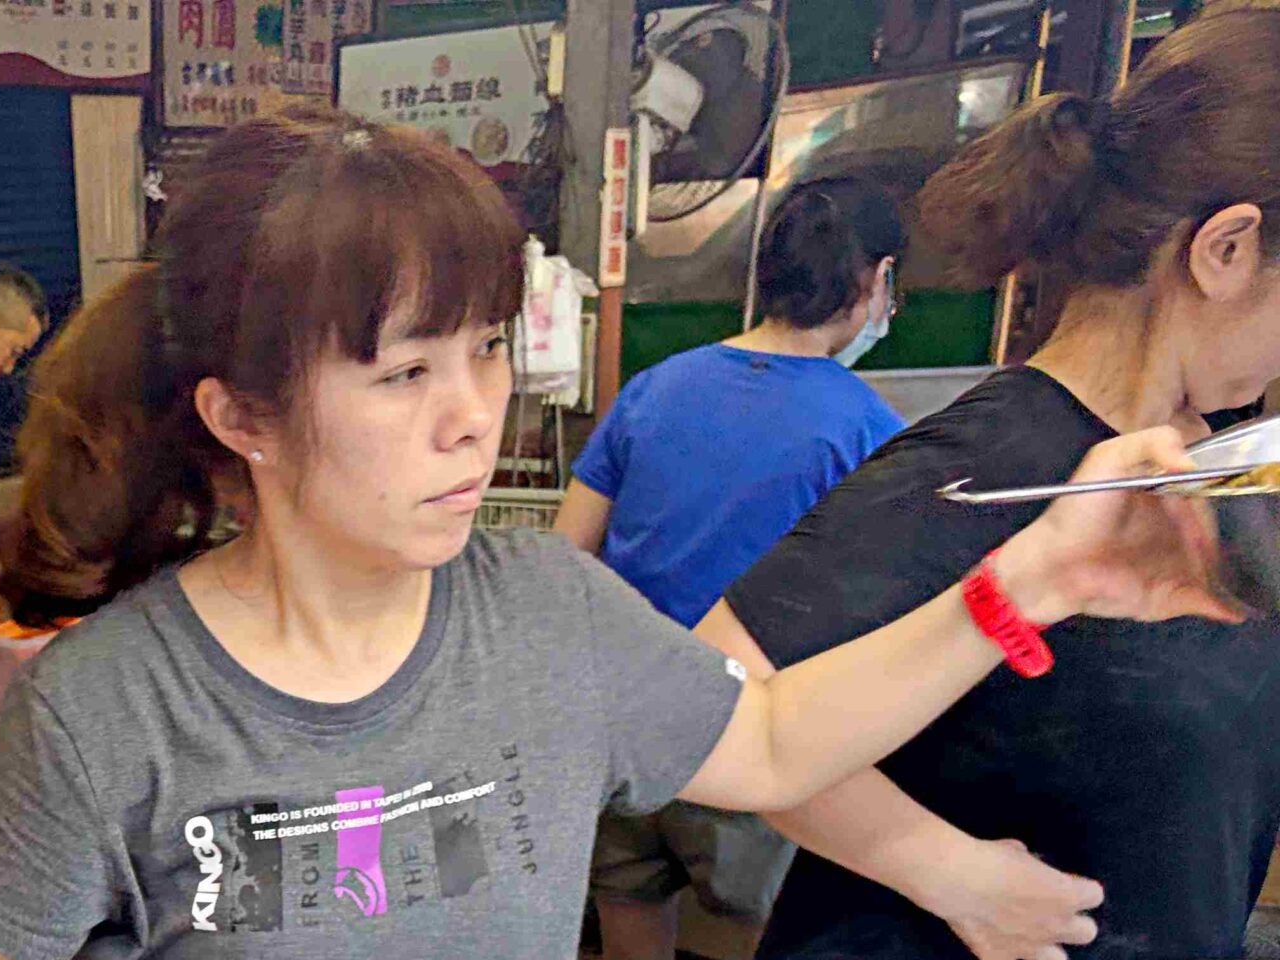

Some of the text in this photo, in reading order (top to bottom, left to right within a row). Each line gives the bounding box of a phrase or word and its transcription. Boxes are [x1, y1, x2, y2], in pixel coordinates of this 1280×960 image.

[251, 812, 289, 824] KINGO
[290, 810, 302, 820] IS
[304, 801, 359, 818] FOUNDED
[360, 799, 372, 810] IN
[252, 829, 277, 840] THE
[277, 822, 329, 838] DESIGNS
[331, 814, 379, 830] COMBINE
[380, 801, 419, 823] FASHION
[420, 796, 443, 809] AND
[444, 781, 496, 804] COMFORT
[502, 743, 537, 875] JUNGLE
[185, 815, 223, 932] KINGO
[300, 842, 319, 927] FROM
[402, 844, 424, 907] THE
